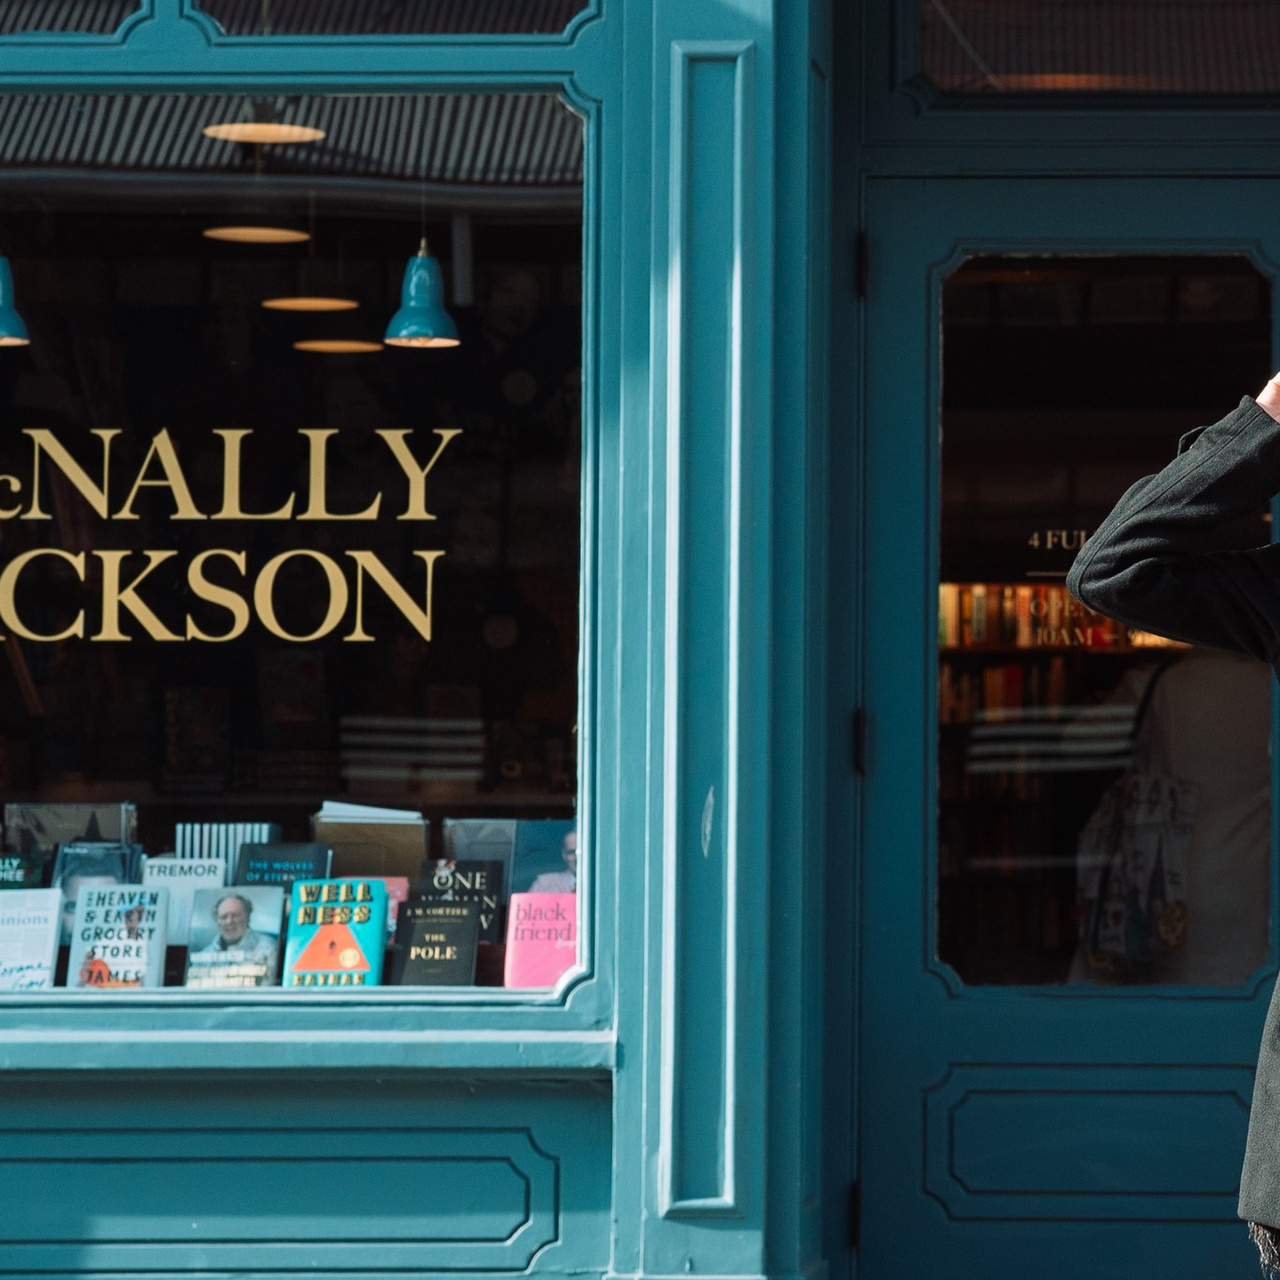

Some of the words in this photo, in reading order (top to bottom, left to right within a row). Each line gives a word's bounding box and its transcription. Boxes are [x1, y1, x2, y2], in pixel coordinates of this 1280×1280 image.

[1027, 531, 1040, 549] 4
[1045, 529, 1090, 550] FUL
[0, 548, 446, 642] CKSON
[1037, 627, 1093, 646] 10AM
[147, 864, 218, 878] TREMOR
[250, 861, 269, 870] THE
[272, 861, 314, 870] WOLVES
[246, 873, 260, 882] OF
[432, 870, 488, 892] ONE
[95, 891, 160, 908] HEAVEN
[299, 882, 374, 904] WELL
[85, 911, 96, 924] &
[296, 904, 371, 926] NESS
[515, 902, 569, 922] black
[81, 927, 157, 943] GROCERY
[424, 933, 447, 942] THE
[513, 923, 573, 942] friend
[90, 945, 143, 959] STORE
[409, 945, 458, 961] POLE
[86, 969, 142, 984] JAMES
[293, 973, 366, 986] NATHAN
